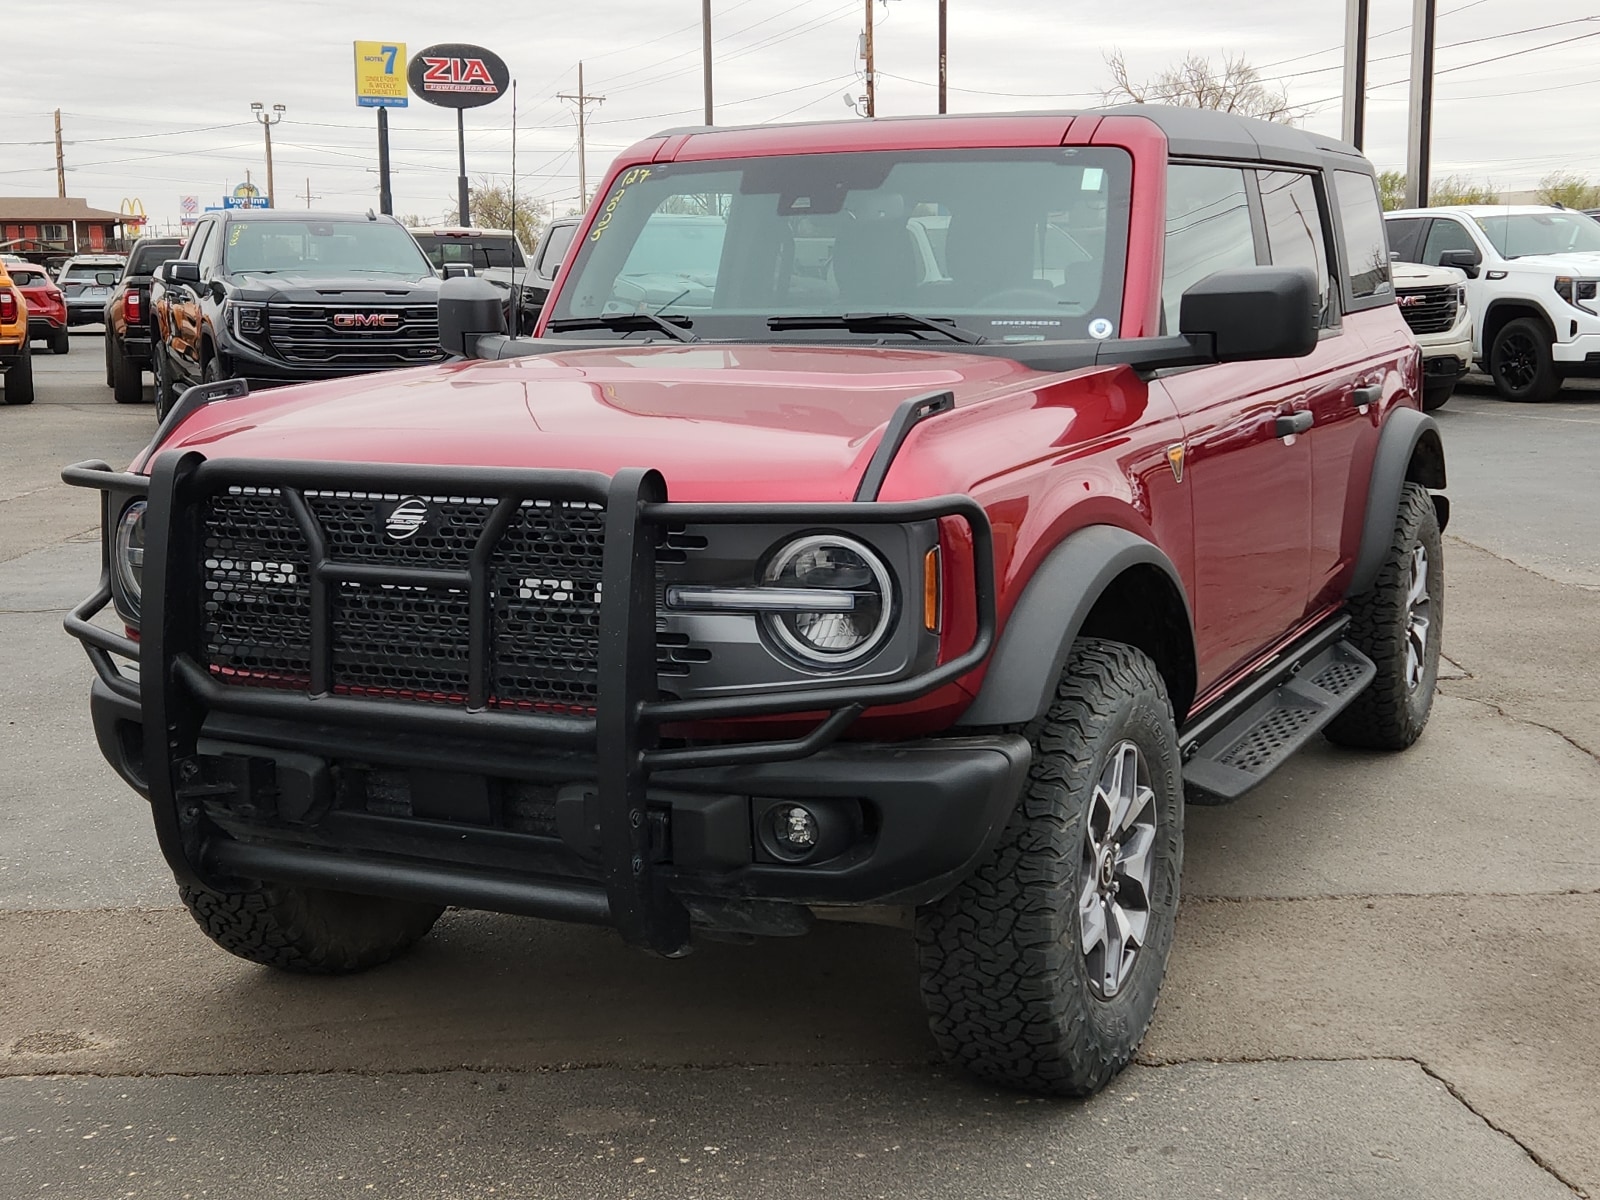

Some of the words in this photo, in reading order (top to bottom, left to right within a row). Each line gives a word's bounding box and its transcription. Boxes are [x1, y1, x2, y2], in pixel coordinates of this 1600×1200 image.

[381, 45, 398, 75] 7
[422, 57, 494, 84] ZIA
[430, 84, 494, 93] POWERSPORTS
[250, 197, 266, 205] Inn
[1394, 294, 1427, 307] MC
[333, 313, 400, 327] GMC
